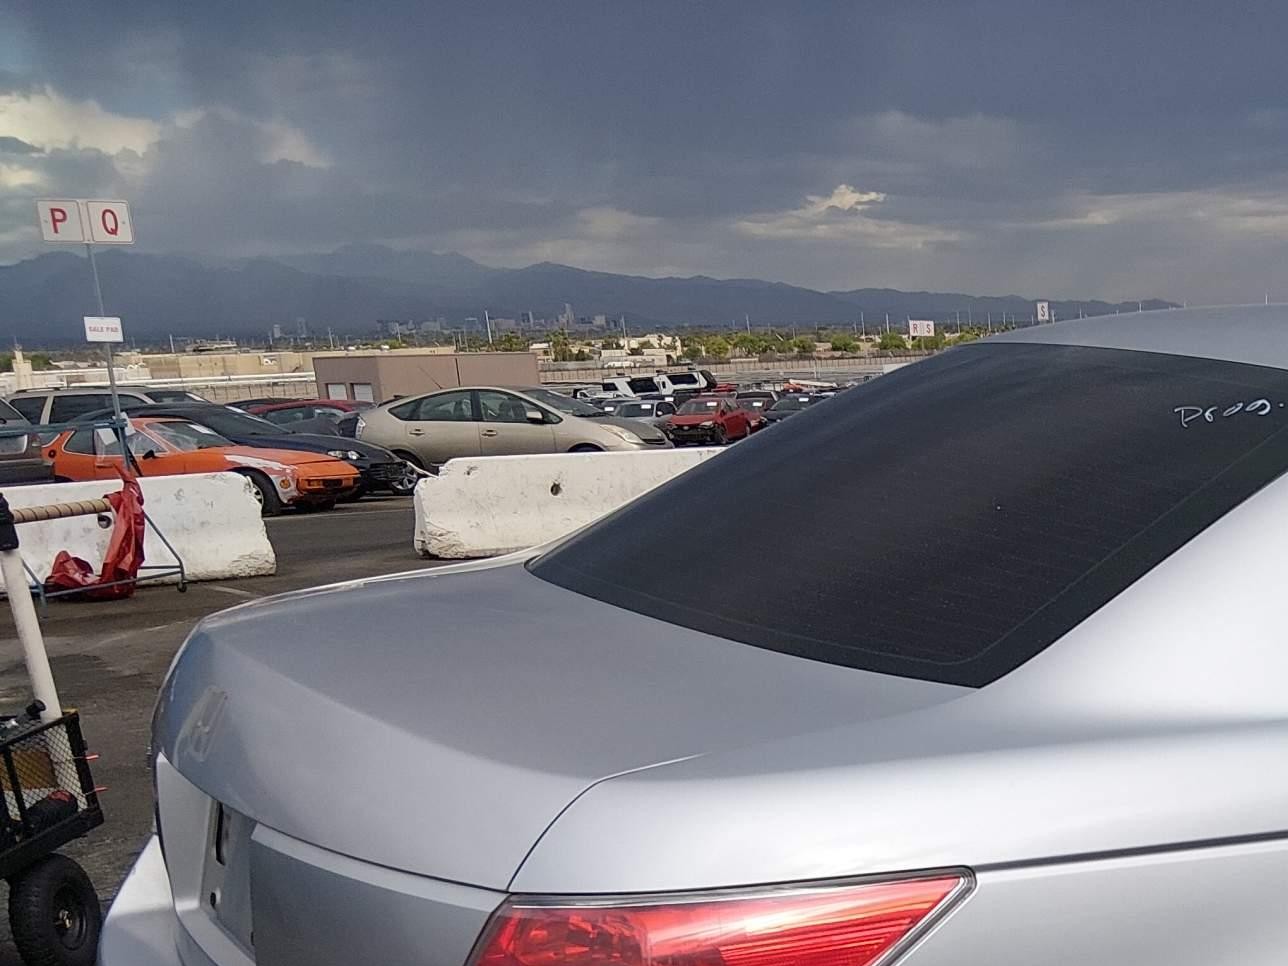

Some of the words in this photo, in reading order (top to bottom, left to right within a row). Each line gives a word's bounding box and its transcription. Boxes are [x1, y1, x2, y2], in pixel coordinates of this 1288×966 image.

[50, 207, 68, 234] P
[101, 208, 119, 236] Q
[912, 323, 918, 334] R
